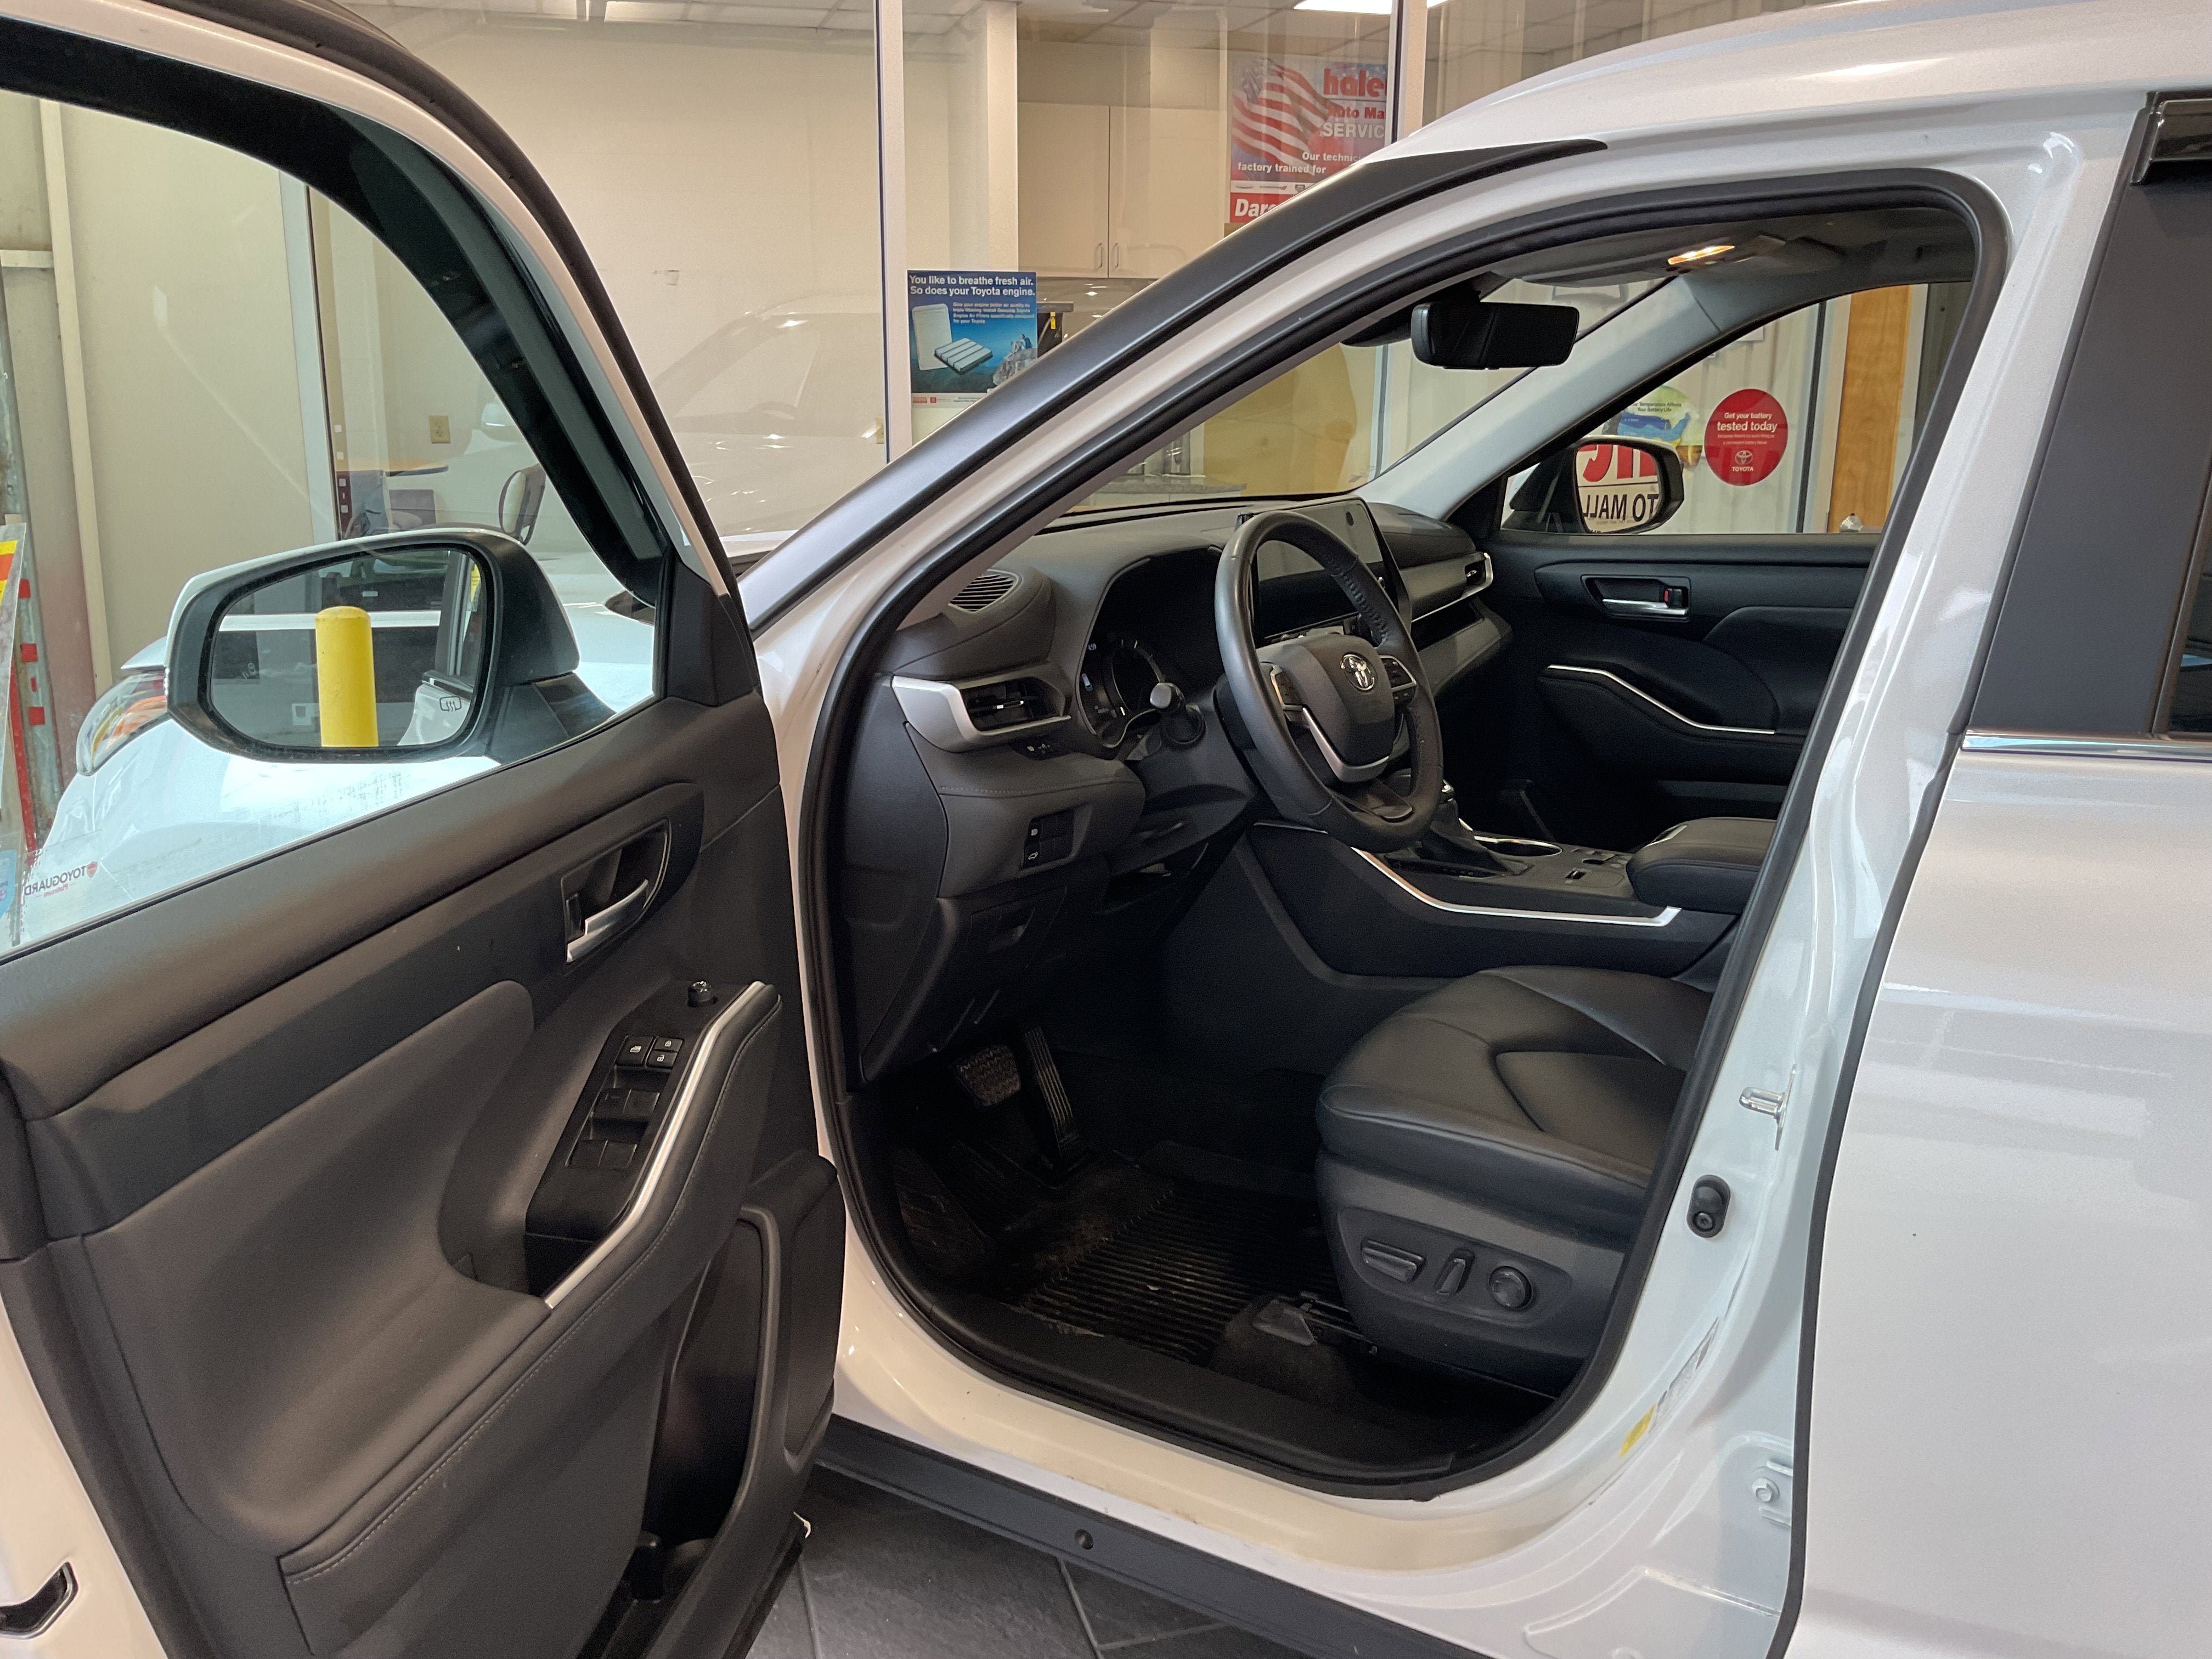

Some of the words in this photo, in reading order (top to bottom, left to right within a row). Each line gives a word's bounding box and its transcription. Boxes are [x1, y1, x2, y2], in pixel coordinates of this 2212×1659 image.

[1324, 69, 1387, 97] hale
[1302, 152, 1320, 161] Our
[1238, 162, 1272, 174] factory
[1275, 162, 1309, 173] trained
[1312, 165, 1327, 174] for
[909, 275, 927, 284] You
[929, 275, 945, 284] like
[947, 276, 957, 284] to
[958, 276, 994, 285] breathe
[995, 276, 1018, 285] fresh
[1020, 277, 1034, 285] air.
[911, 285, 923, 295] So
[925, 286, 947, 295] does
[949, 288, 969, 297] your
[970, 286, 1001, 297] Toyota
[1002, 287, 1035, 297] engine.
[1717, 421, 1748, 431] tested
[1751, 421, 1778, 433] today
